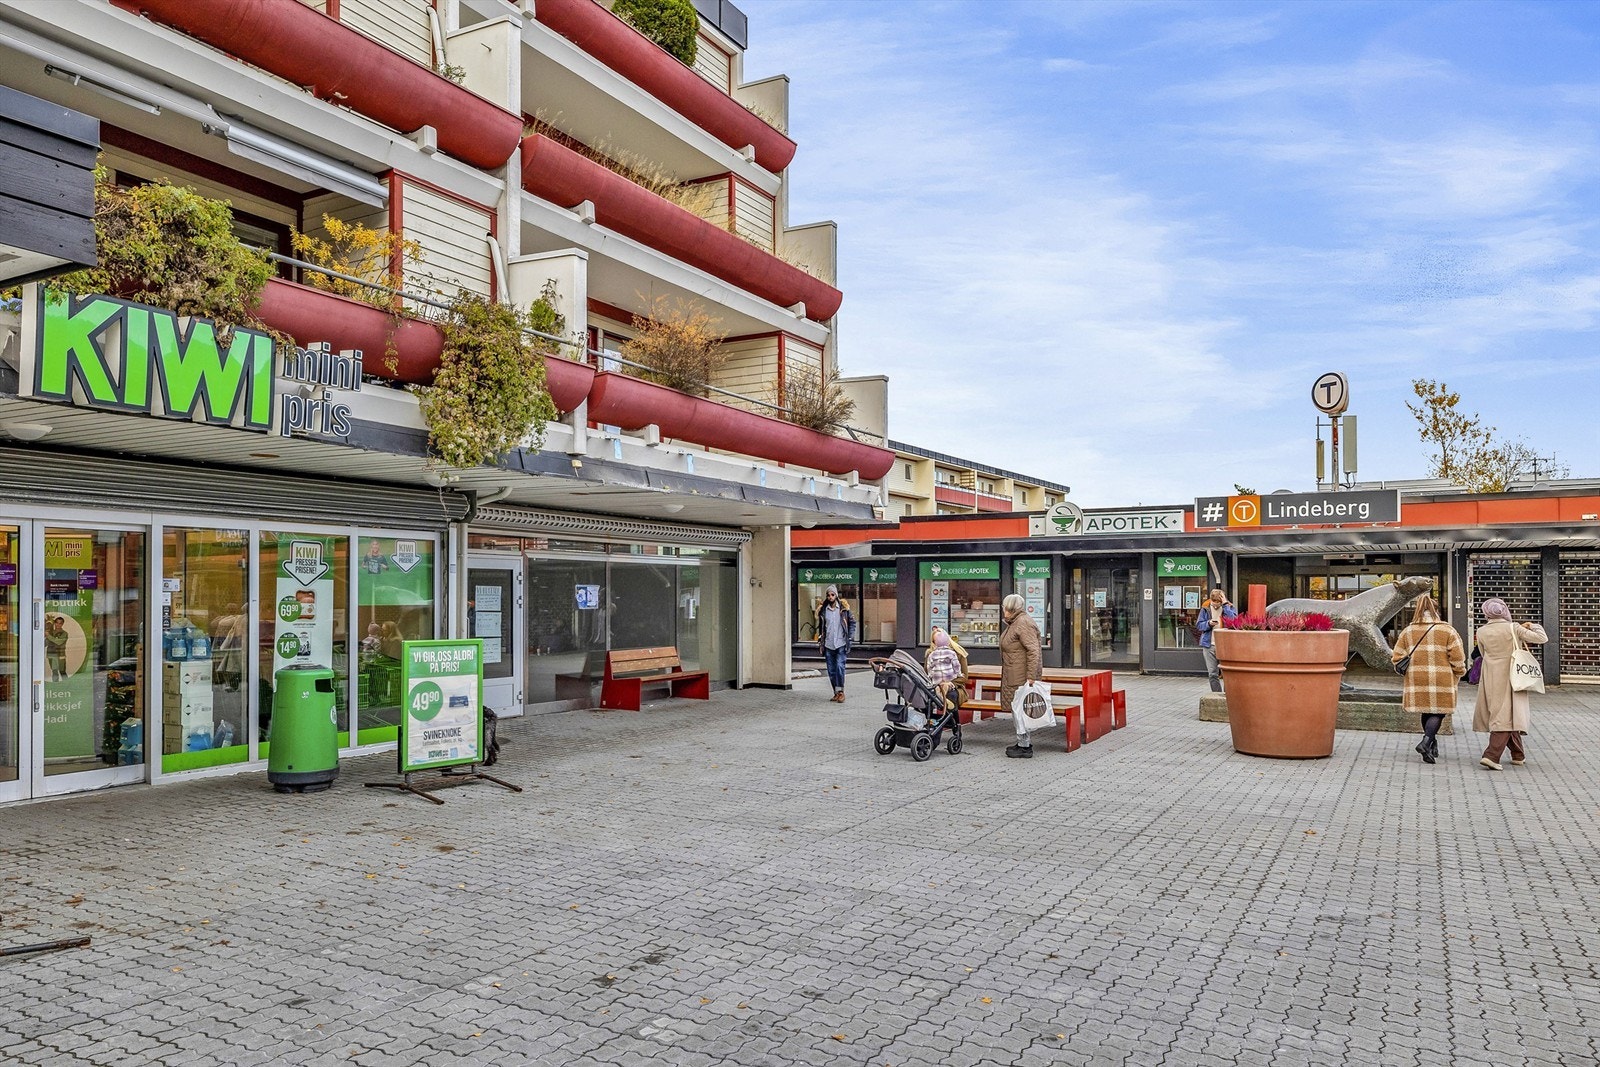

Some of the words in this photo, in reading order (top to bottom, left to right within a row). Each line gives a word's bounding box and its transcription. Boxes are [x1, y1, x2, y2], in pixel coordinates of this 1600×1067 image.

[41, 288, 273, 425] KIWI
[283, 341, 363, 392] mini
[1320, 381, 1337, 404] T
[282, 391, 353, 437] pris
[1268, 500, 1370, 519] Lindeberg
[1086, 516, 1169, 531] APOTEK
[65, 550, 81, 558] pris
[295, 546, 318, 559] KIWI
[399, 544, 414, 553] KIWI
[295, 558, 317, 567] PRESSER
[295, 566, 317, 575] PRISENE!
[52, 598, 87, 607] butikk
[413, 652, 421, 662] VI
[423, 651, 435, 662] GIR
[437, 651, 452, 661] OSS
[441, 661, 460, 673] PRIS!
[46, 690, 71, 699] ilsen
[423, 727, 462, 740] SVINEKNOKE
